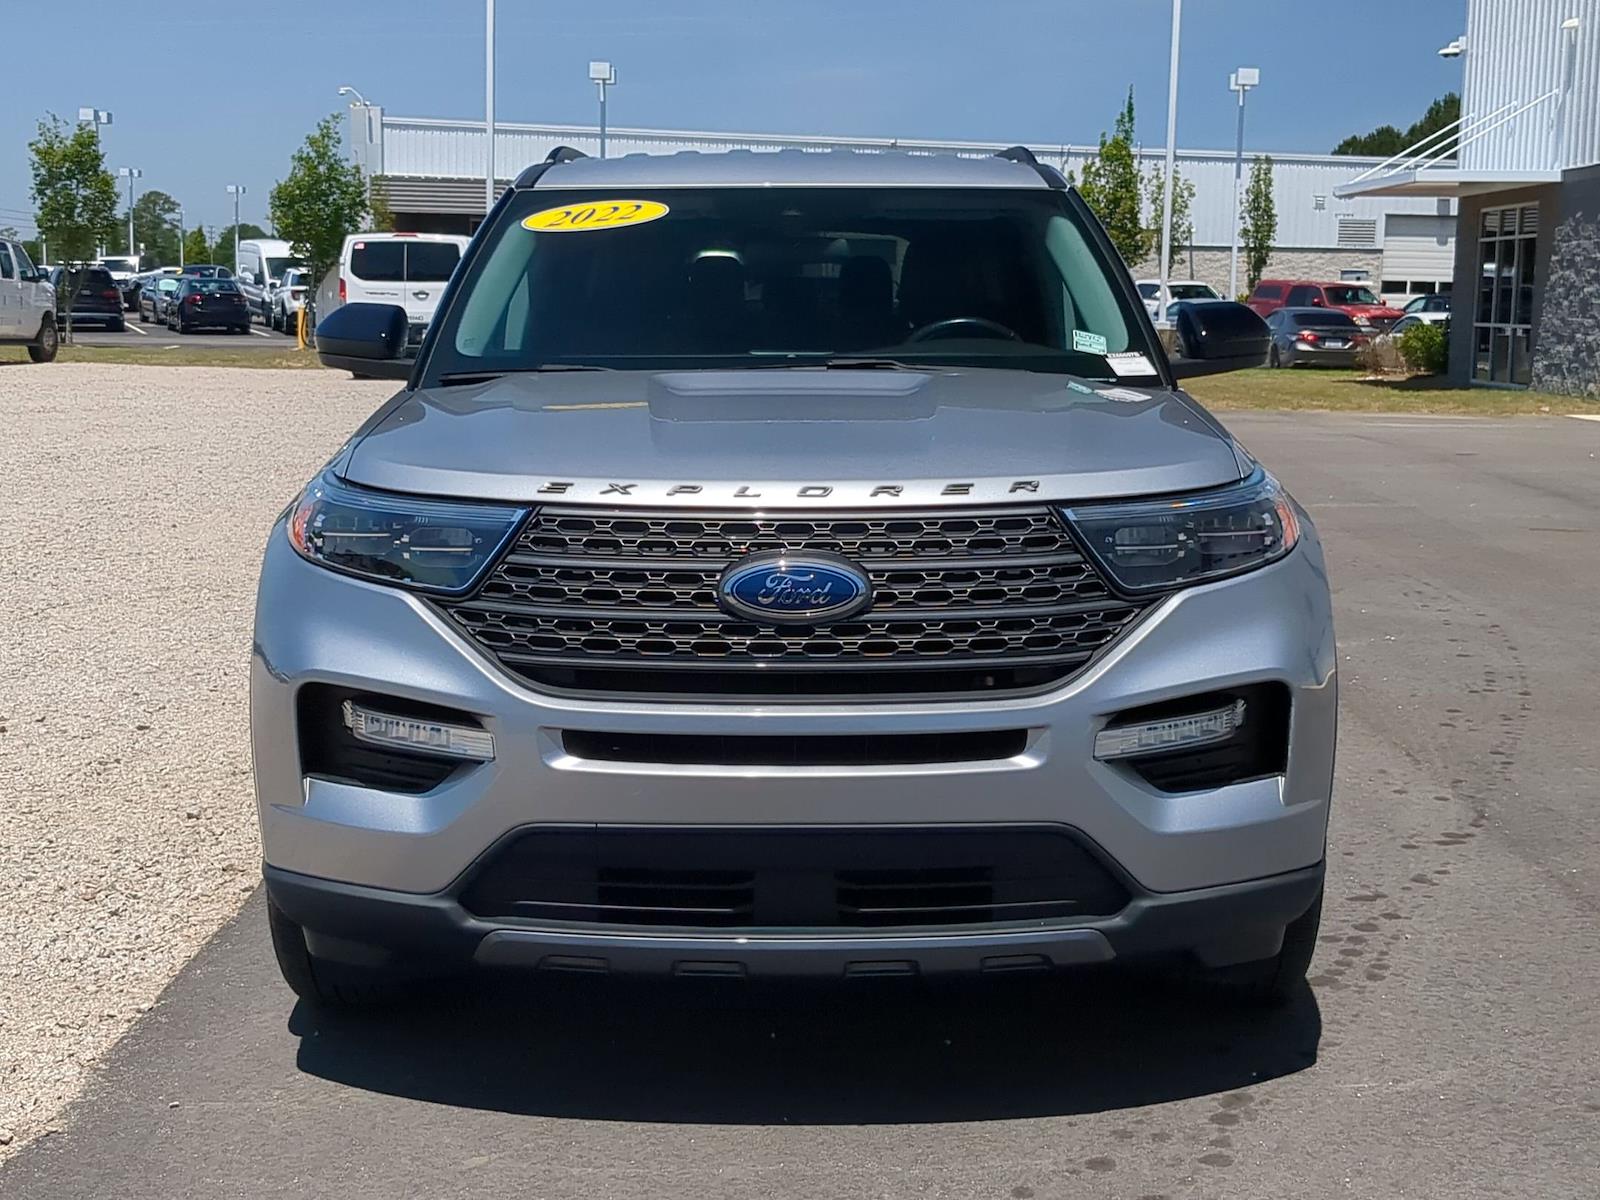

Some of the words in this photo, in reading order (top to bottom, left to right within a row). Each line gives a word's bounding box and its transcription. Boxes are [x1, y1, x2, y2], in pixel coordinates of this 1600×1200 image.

[544, 204, 642, 227] 2022
[536, 480, 1041, 498] EXPLORER
[758, 573, 833, 605] Ford
